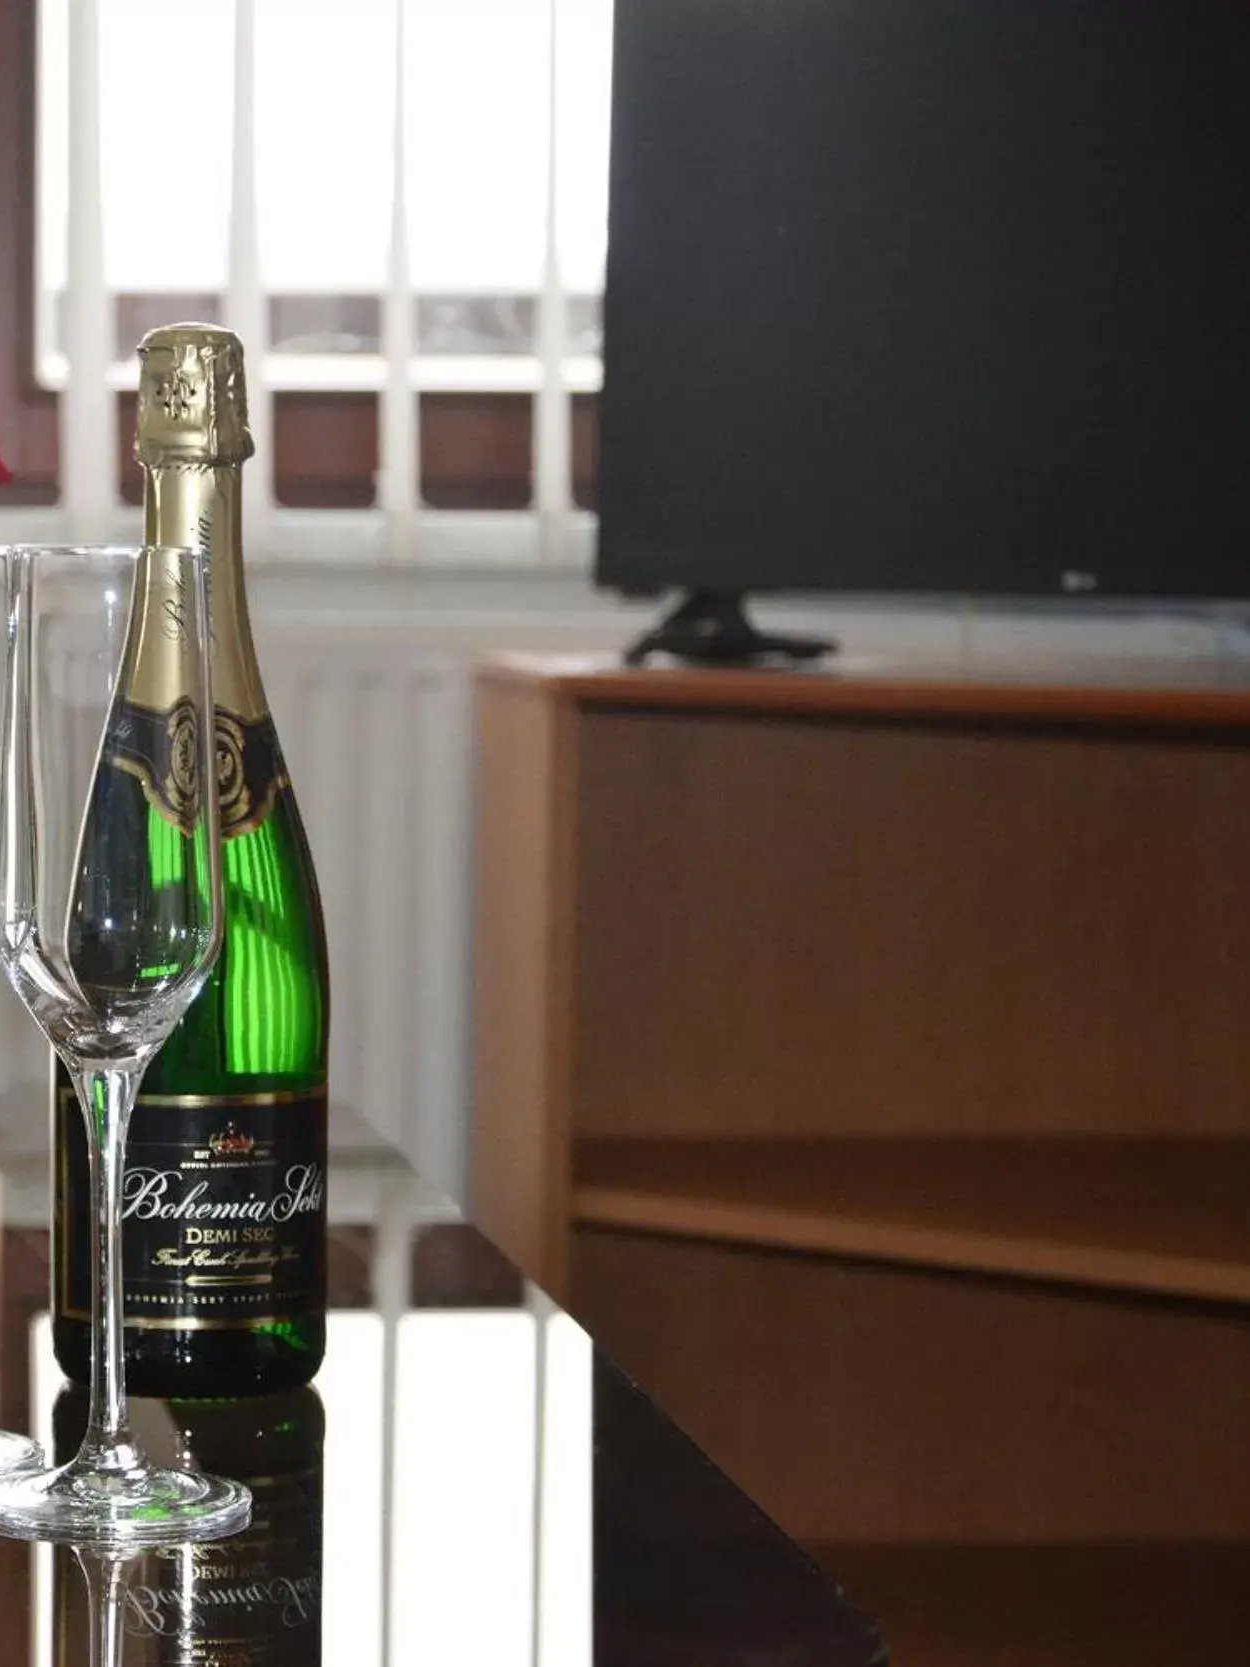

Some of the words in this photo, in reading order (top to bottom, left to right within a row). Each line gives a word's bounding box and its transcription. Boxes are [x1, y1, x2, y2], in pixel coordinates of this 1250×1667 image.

[121, 1166, 268, 1222] Bohemia
[184, 1227, 239, 1244] DEMI
[242, 1226, 276, 1243] SEC
